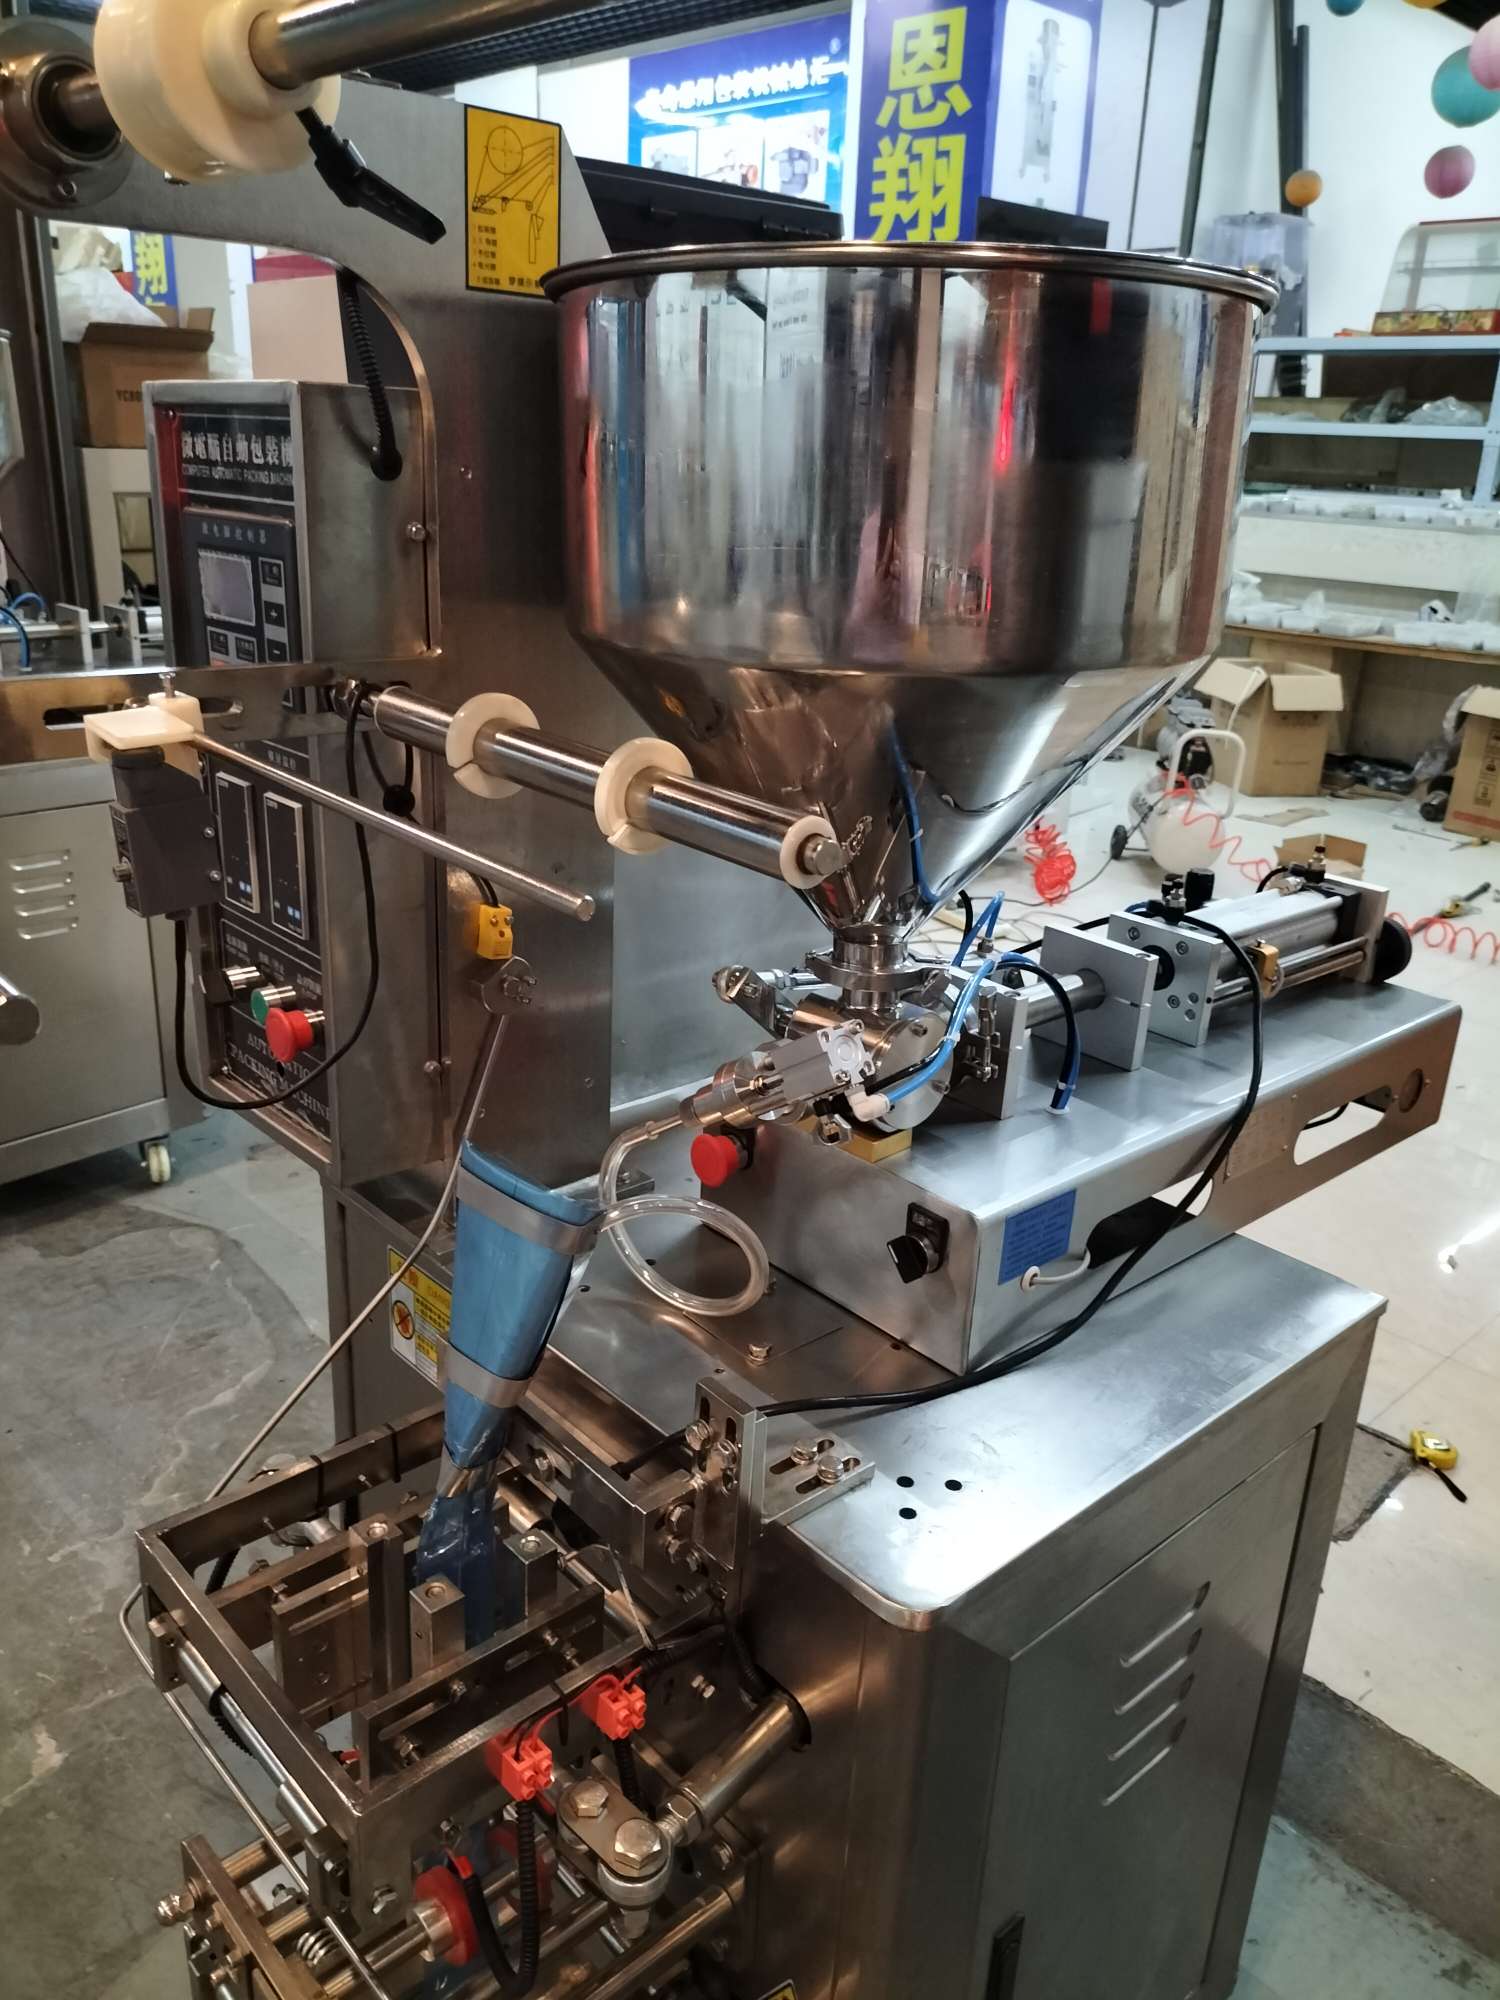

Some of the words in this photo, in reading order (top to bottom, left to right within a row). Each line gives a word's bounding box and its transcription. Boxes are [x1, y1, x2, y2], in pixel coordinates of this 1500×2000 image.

[869, 5, 972, 241] 恩翔
[133, 231, 168, 304] 翔
[270, 471, 293, 486] MACHIN
[228, 1041, 276, 1086] PACKING
